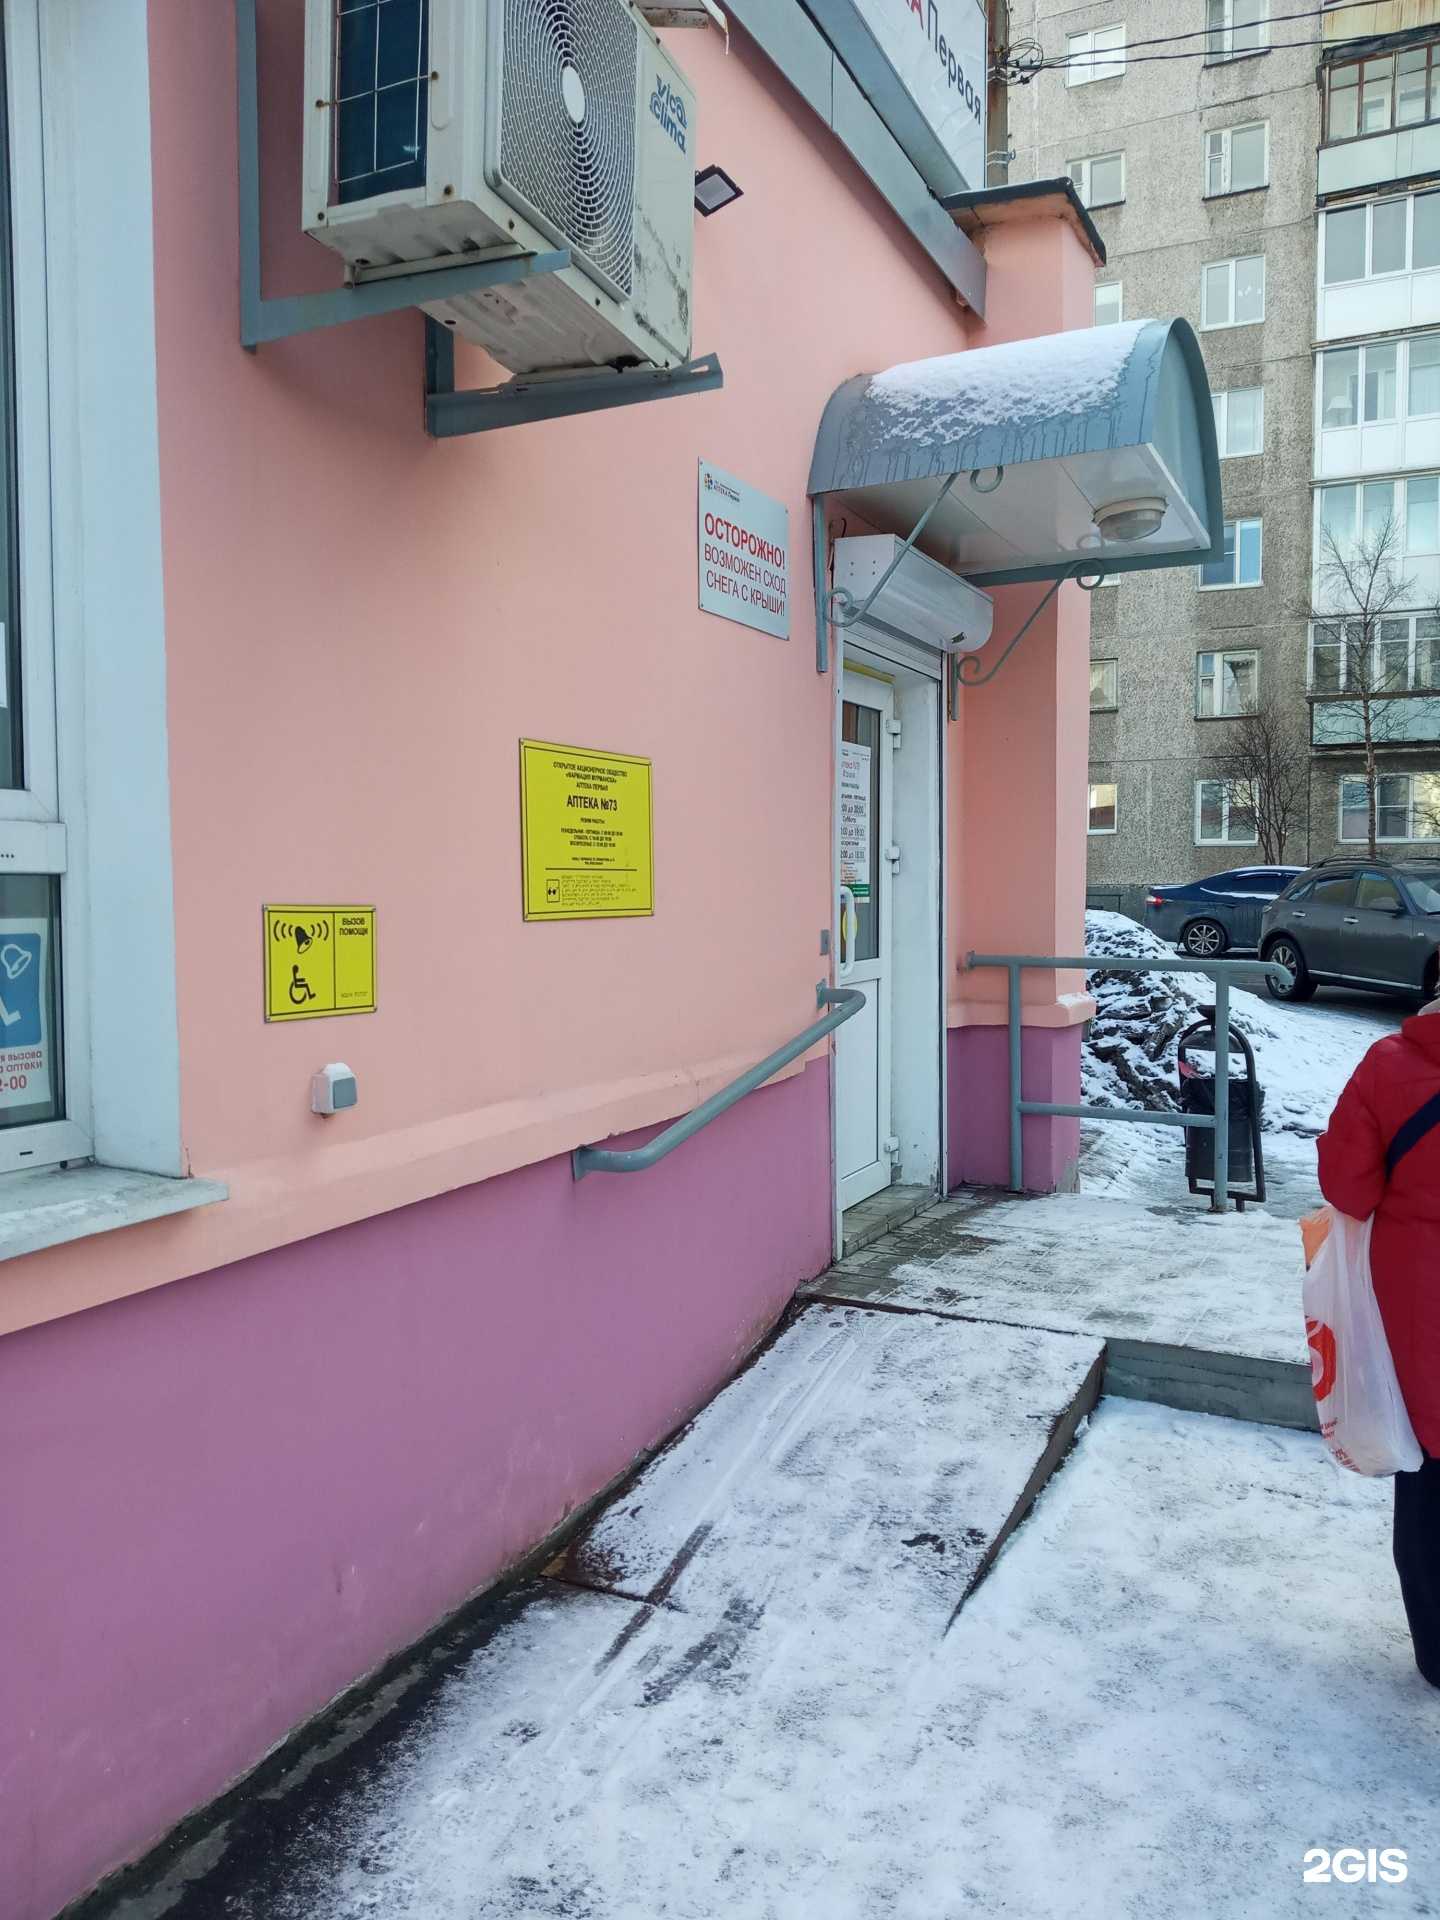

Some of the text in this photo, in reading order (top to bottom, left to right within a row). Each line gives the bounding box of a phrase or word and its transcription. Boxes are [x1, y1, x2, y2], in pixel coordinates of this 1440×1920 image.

[927, 0, 981, 125] Первая
[650, 92, 686, 153] clima
[704, 512, 785, 570] ОСТОРОЖНО!
[704, 543, 787, 598] ВОЗМОЖЕН СХОД
[706, 569, 785, 617] СНЕГА С КРЫШИ!
[566, 794, 618, 812] АПТЕКА №73
[339, 927, 369, 936] ПОМОЩИ
[342, 917, 365, 926] ВЫЗОВ
[6, 1061, 42, 1073] аптеки
[7, 1050, 42, 1062] вызова
